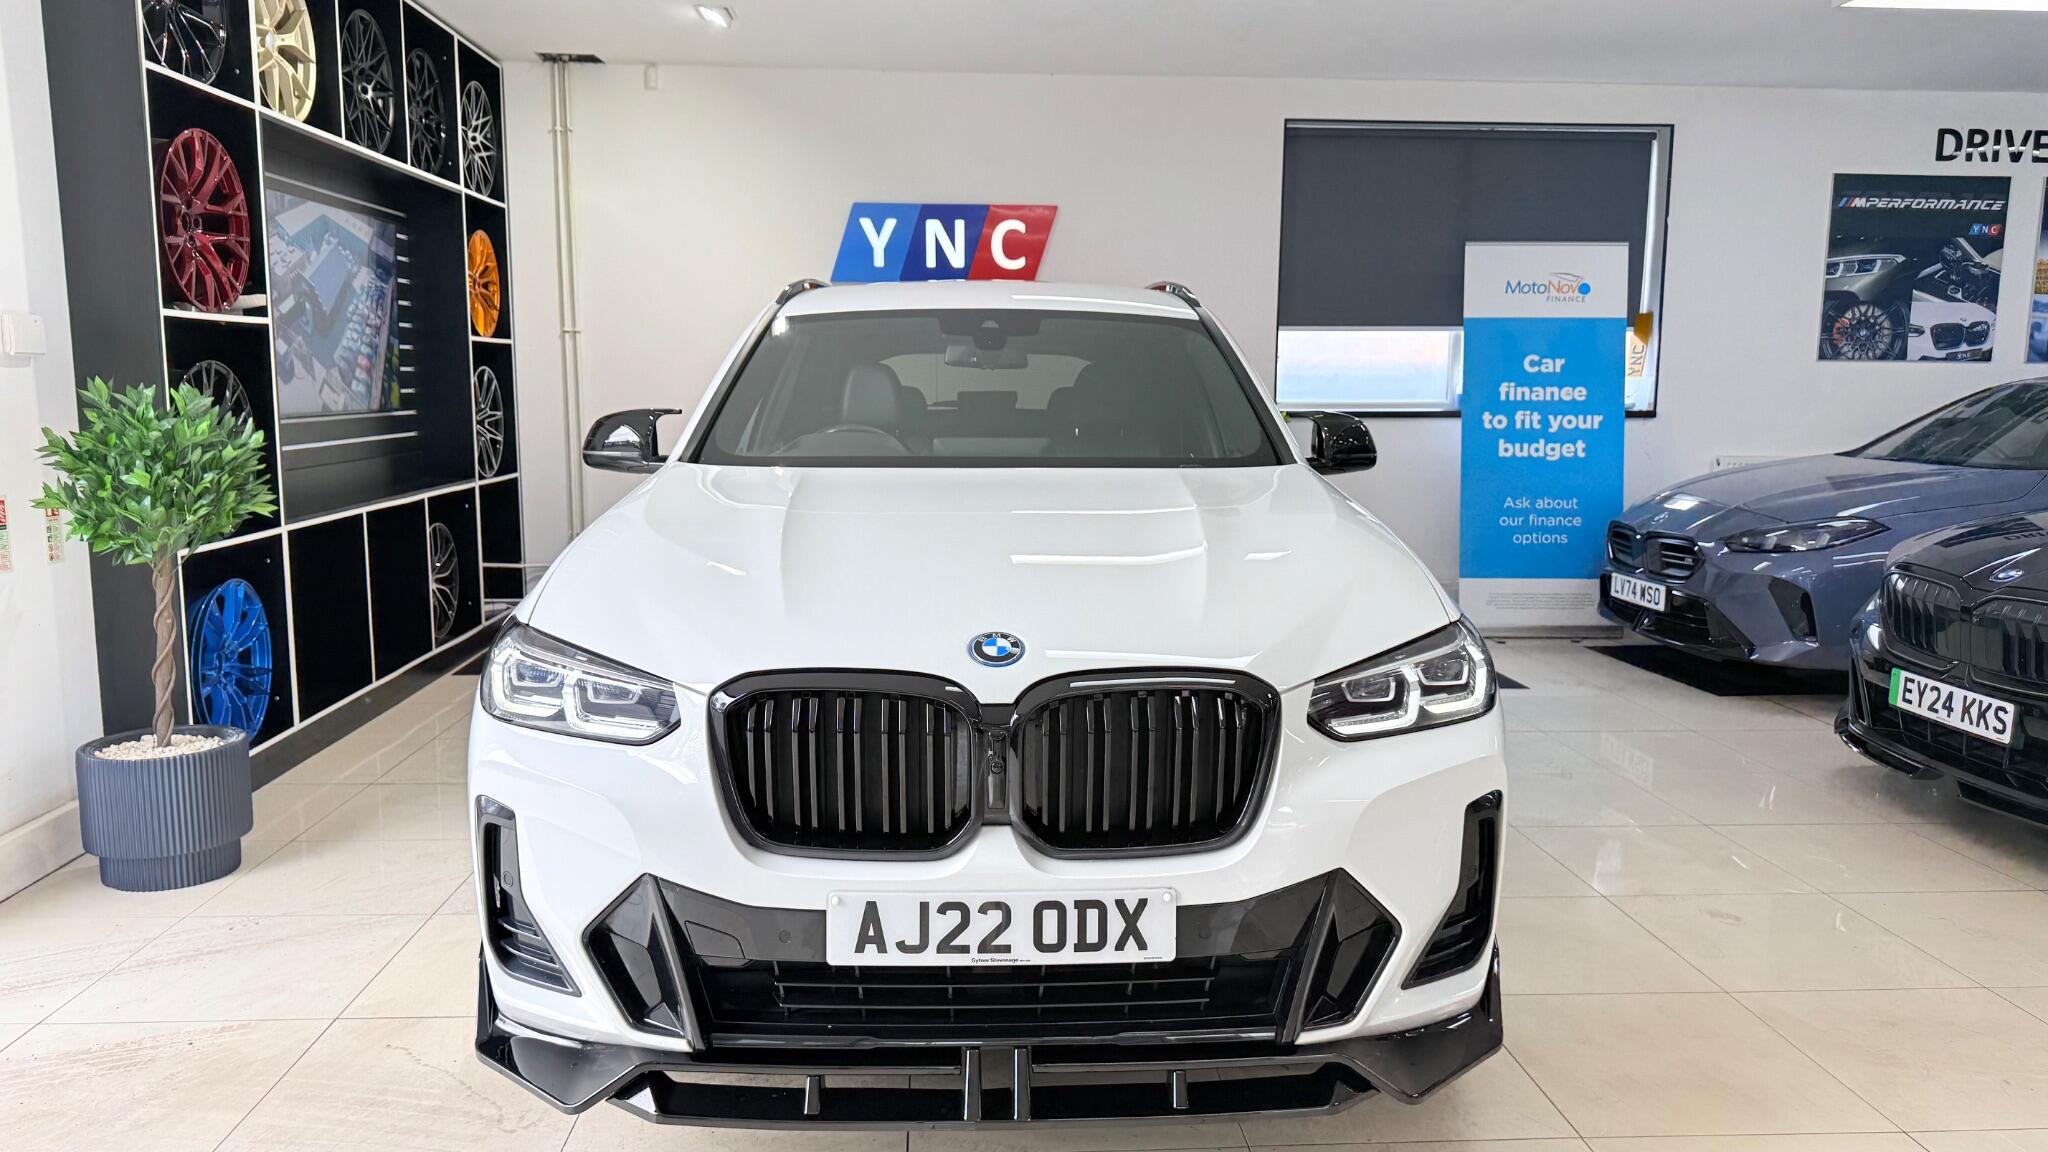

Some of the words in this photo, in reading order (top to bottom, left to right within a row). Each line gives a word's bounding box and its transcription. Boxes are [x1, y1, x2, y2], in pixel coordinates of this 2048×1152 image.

[1935, 128, 2048, 163] DRIVE
[859, 217, 1026, 270] YNC
[1523, 354, 1566, 373] Car
[1499, 382, 1588, 401] finance
[1482, 411, 1508, 429] to
[1514, 410, 1542, 429] fit
[1547, 414, 1603, 433] your
[1498, 438, 1586, 461] budget
[1503, 497, 1531, 509] Ask
[1535, 496, 1578, 509] about
[1499, 516, 1523, 527] our
[1529, 514, 1582, 527] finance
[1512, 534, 1568, 546] options
[1901, 676, 1954, 719] EY24
[1960, 694, 2009, 735] KKS
[854, 900, 1012, 954] AJ22
[1032, 897, 1148, 953] ODX
